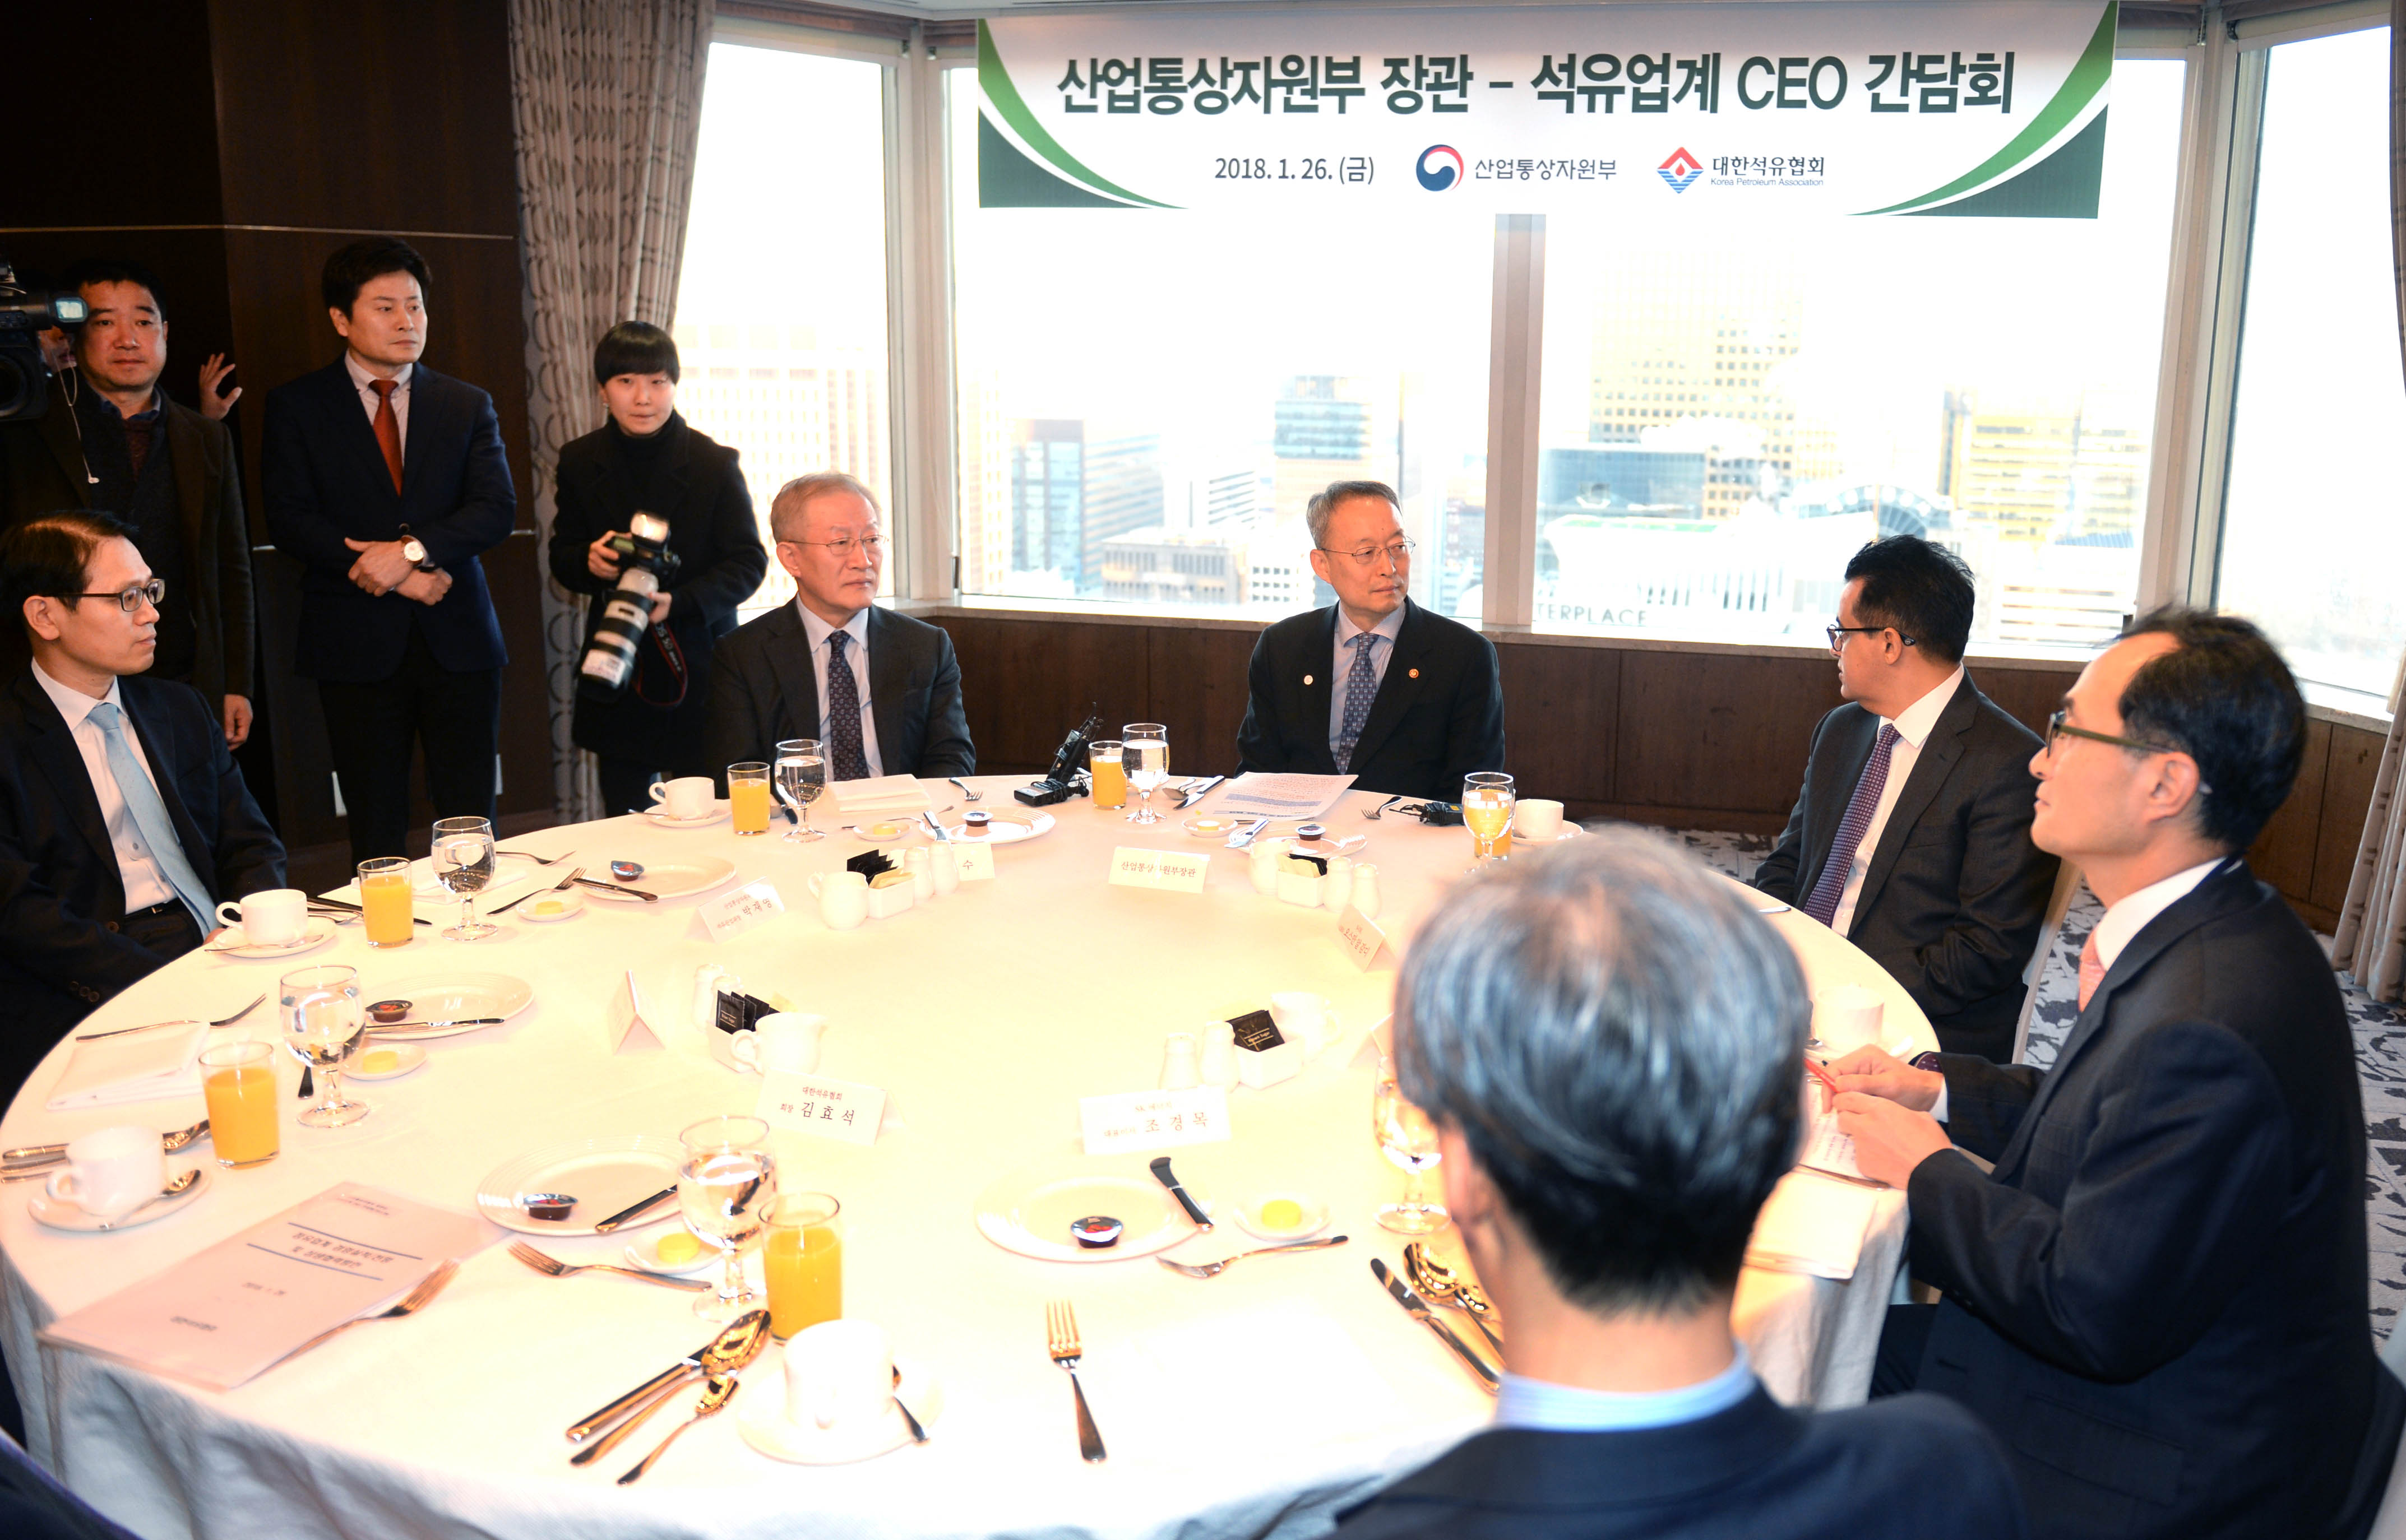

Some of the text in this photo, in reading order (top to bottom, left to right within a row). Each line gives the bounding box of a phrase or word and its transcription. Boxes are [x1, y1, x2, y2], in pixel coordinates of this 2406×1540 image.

[1057, 54, 1365, 115] 산업통상자원부
[1381, 54, 1474, 114] 장관
[1530, 52, 1722, 114] 석유업계
[1737, 55, 1848, 110] CEO
[1864, 51, 2015, 113] 간담회
[1215, 157, 1271, 179] 2018.
[1339, 156, 1374, 185] (금)
[1475, 159, 1617, 180] 산업통상자원부
[1713, 156, 1824, 177] 대한석유협회
[1710, 177, 1824, 187] Korea Petroleum Association
[802, 1086, 843, 1101] 대한석유협회
